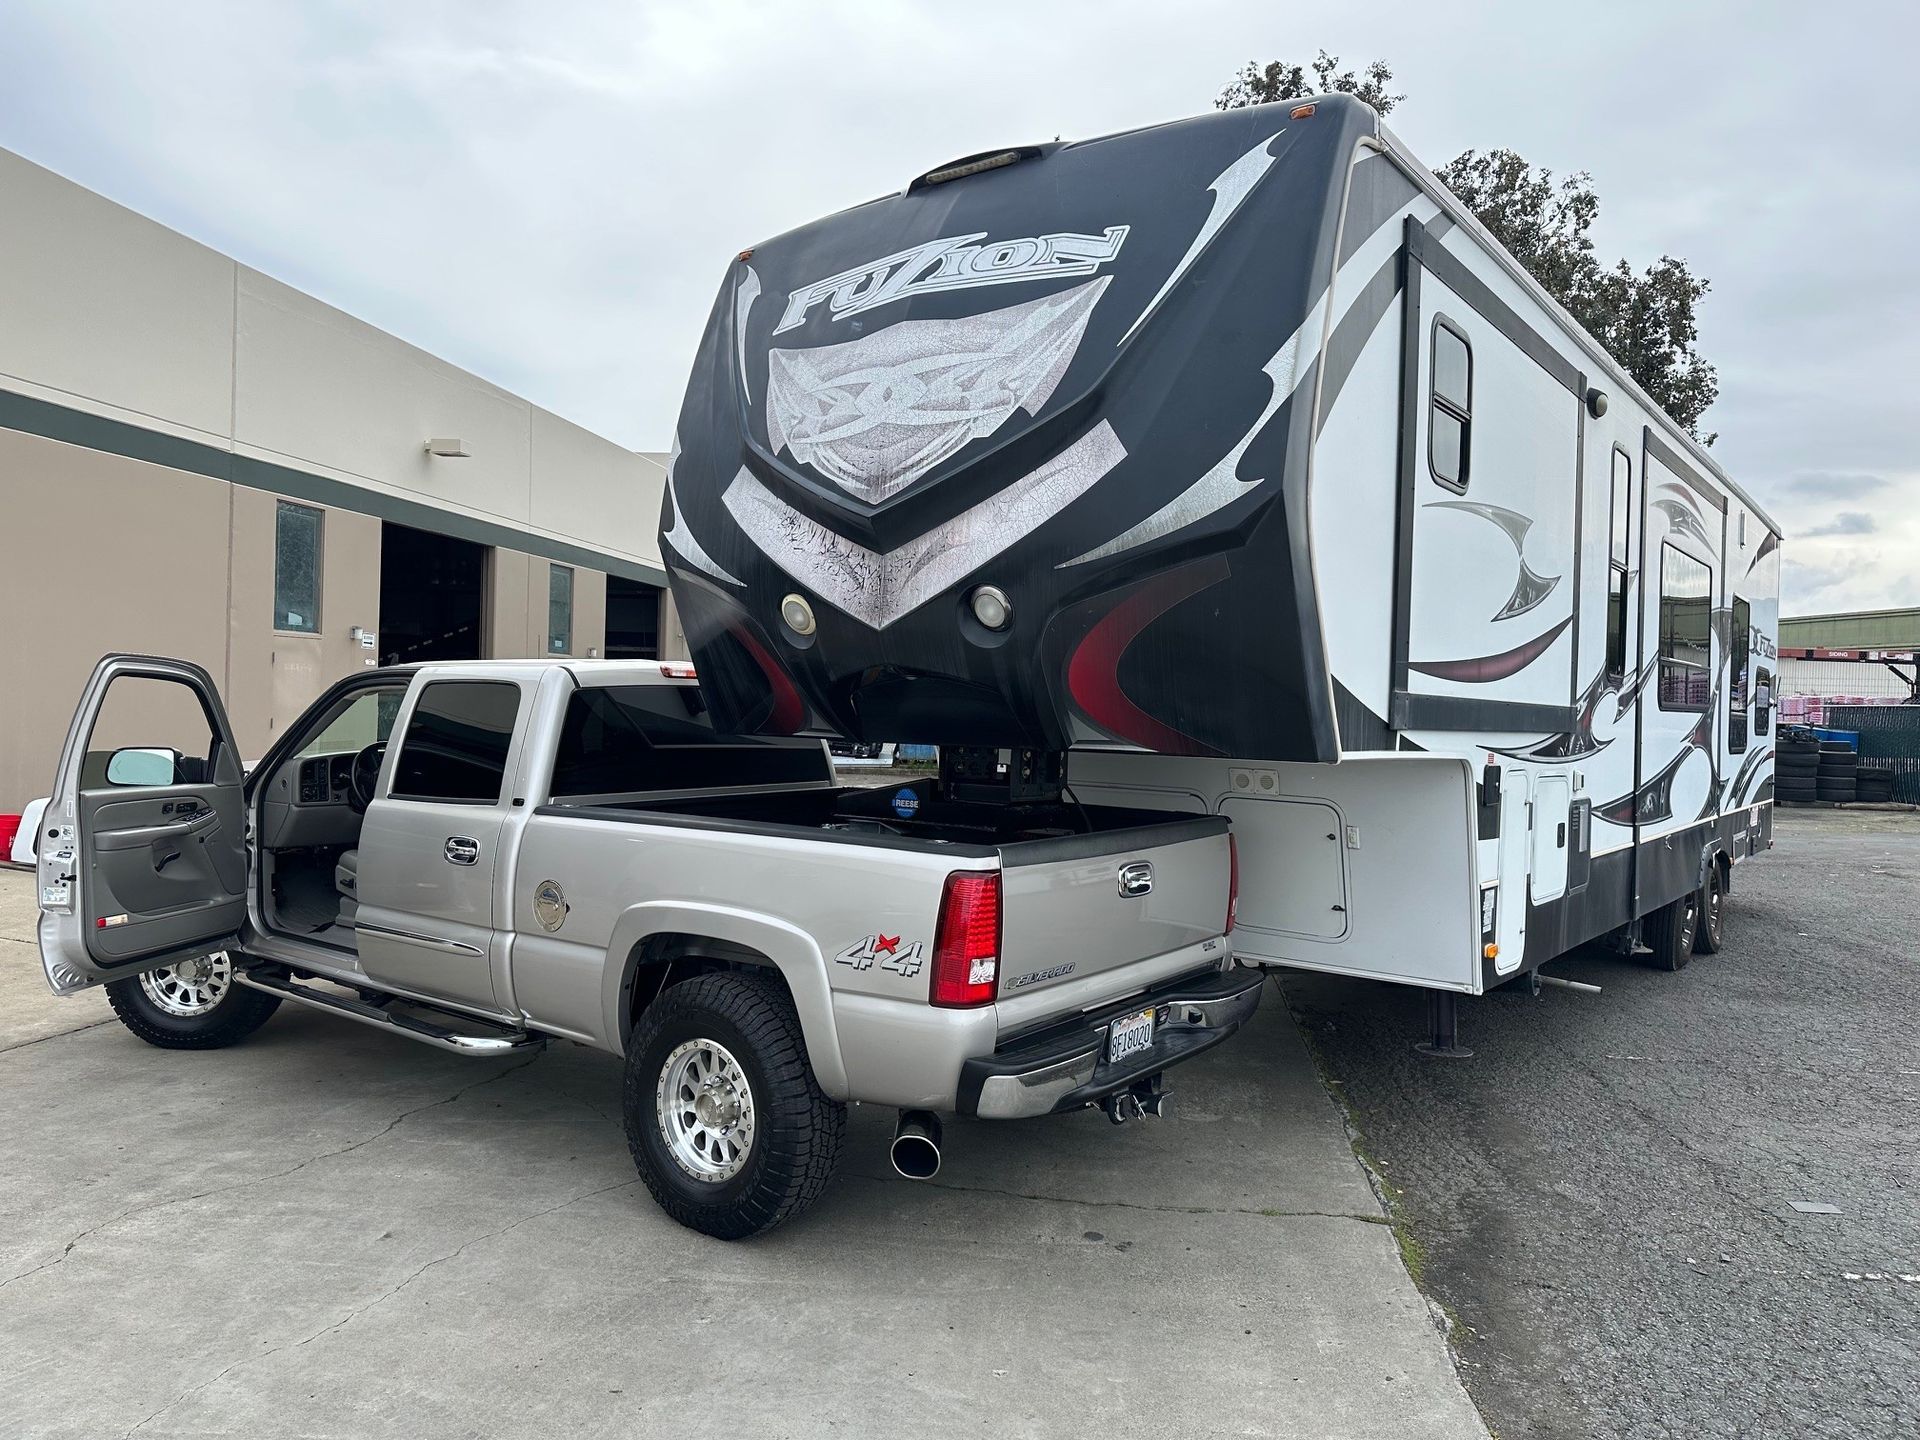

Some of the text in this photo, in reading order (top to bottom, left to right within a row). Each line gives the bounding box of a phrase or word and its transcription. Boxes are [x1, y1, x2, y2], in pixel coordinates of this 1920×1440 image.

[773, 225, 1130, 335] FUZION
[895, 799, 919, 808] REESE
[1016, 962, 1076, 988] SILVERADO
